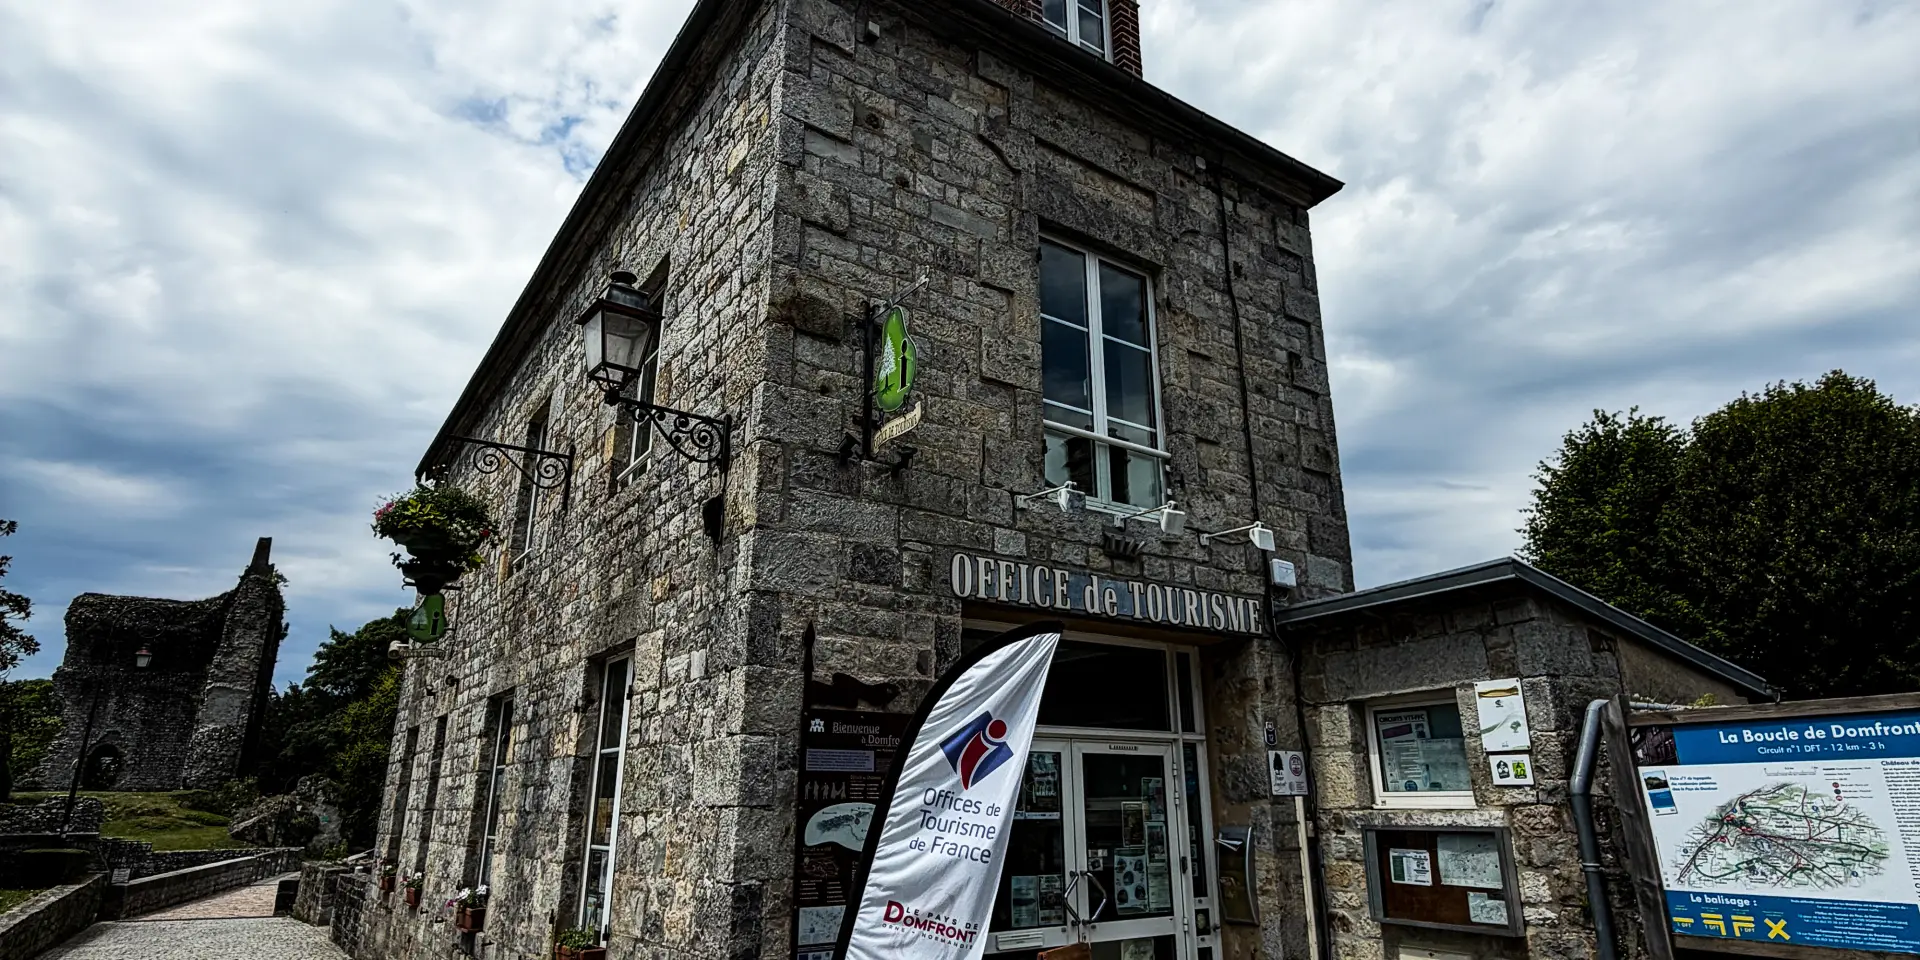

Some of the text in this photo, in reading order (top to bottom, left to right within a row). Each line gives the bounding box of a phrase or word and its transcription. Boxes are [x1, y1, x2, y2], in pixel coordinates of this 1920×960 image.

[951, 553, 1263, 635] OFFICE de TOURISME
[832, 721, 880, 734] Bienvenue
[1718, 721, 1920, 744] La Boucle de Domfront
[868, 734, 901, 746] Domfro
[1757, 745, 1784, 755] Circuit
[1804, 744, 1821, 753] DFT
[1831, 743, 1844, 752] 12
[1845, 742, 1860, 751] km
[1869, 741, 1876, 750] 3
[1878, 741, 1885, 750] h
[923, 787, 1001, 817] Offices de
[919, 809, 996, 840] Tourisme
[909, 836, 991, 864] de France
[1689, 893, 1702, 903] Le
[1704, 894, 1750, 907] balisage
[882, 923, 905, 933] ORNE
[906, 907, 979, 930] LE PAYS DE
